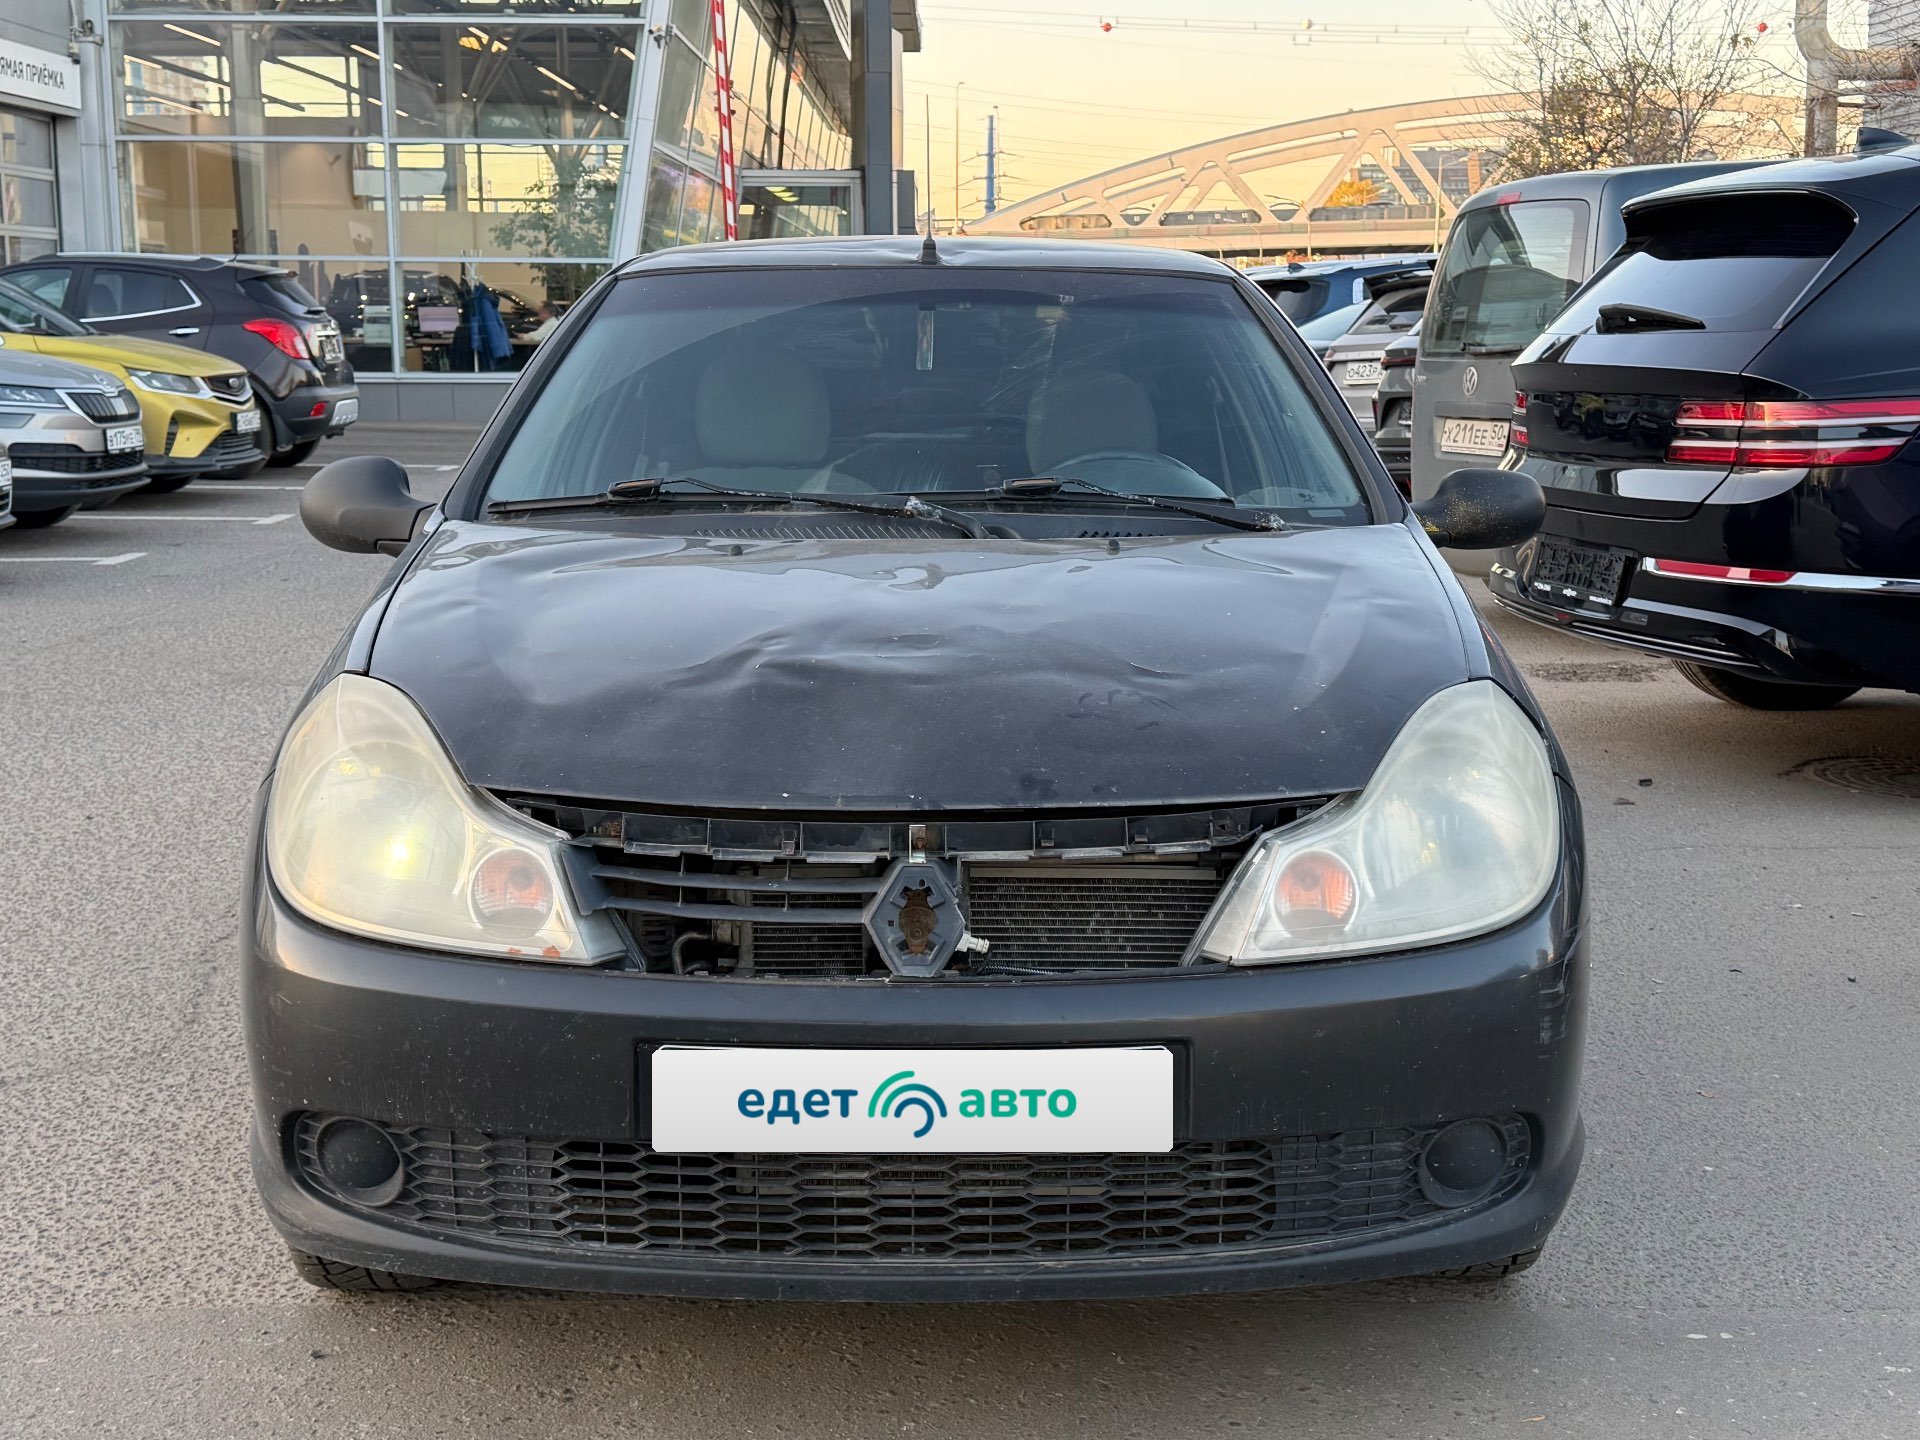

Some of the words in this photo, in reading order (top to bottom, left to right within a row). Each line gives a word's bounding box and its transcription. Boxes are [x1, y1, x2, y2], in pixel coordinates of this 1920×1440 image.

[26, 63, 65, 89] ПРИЁМКА
[1446, 423, 1489, 446] Х211ЕЕ
[1491, 423, 1505, 441] 50
